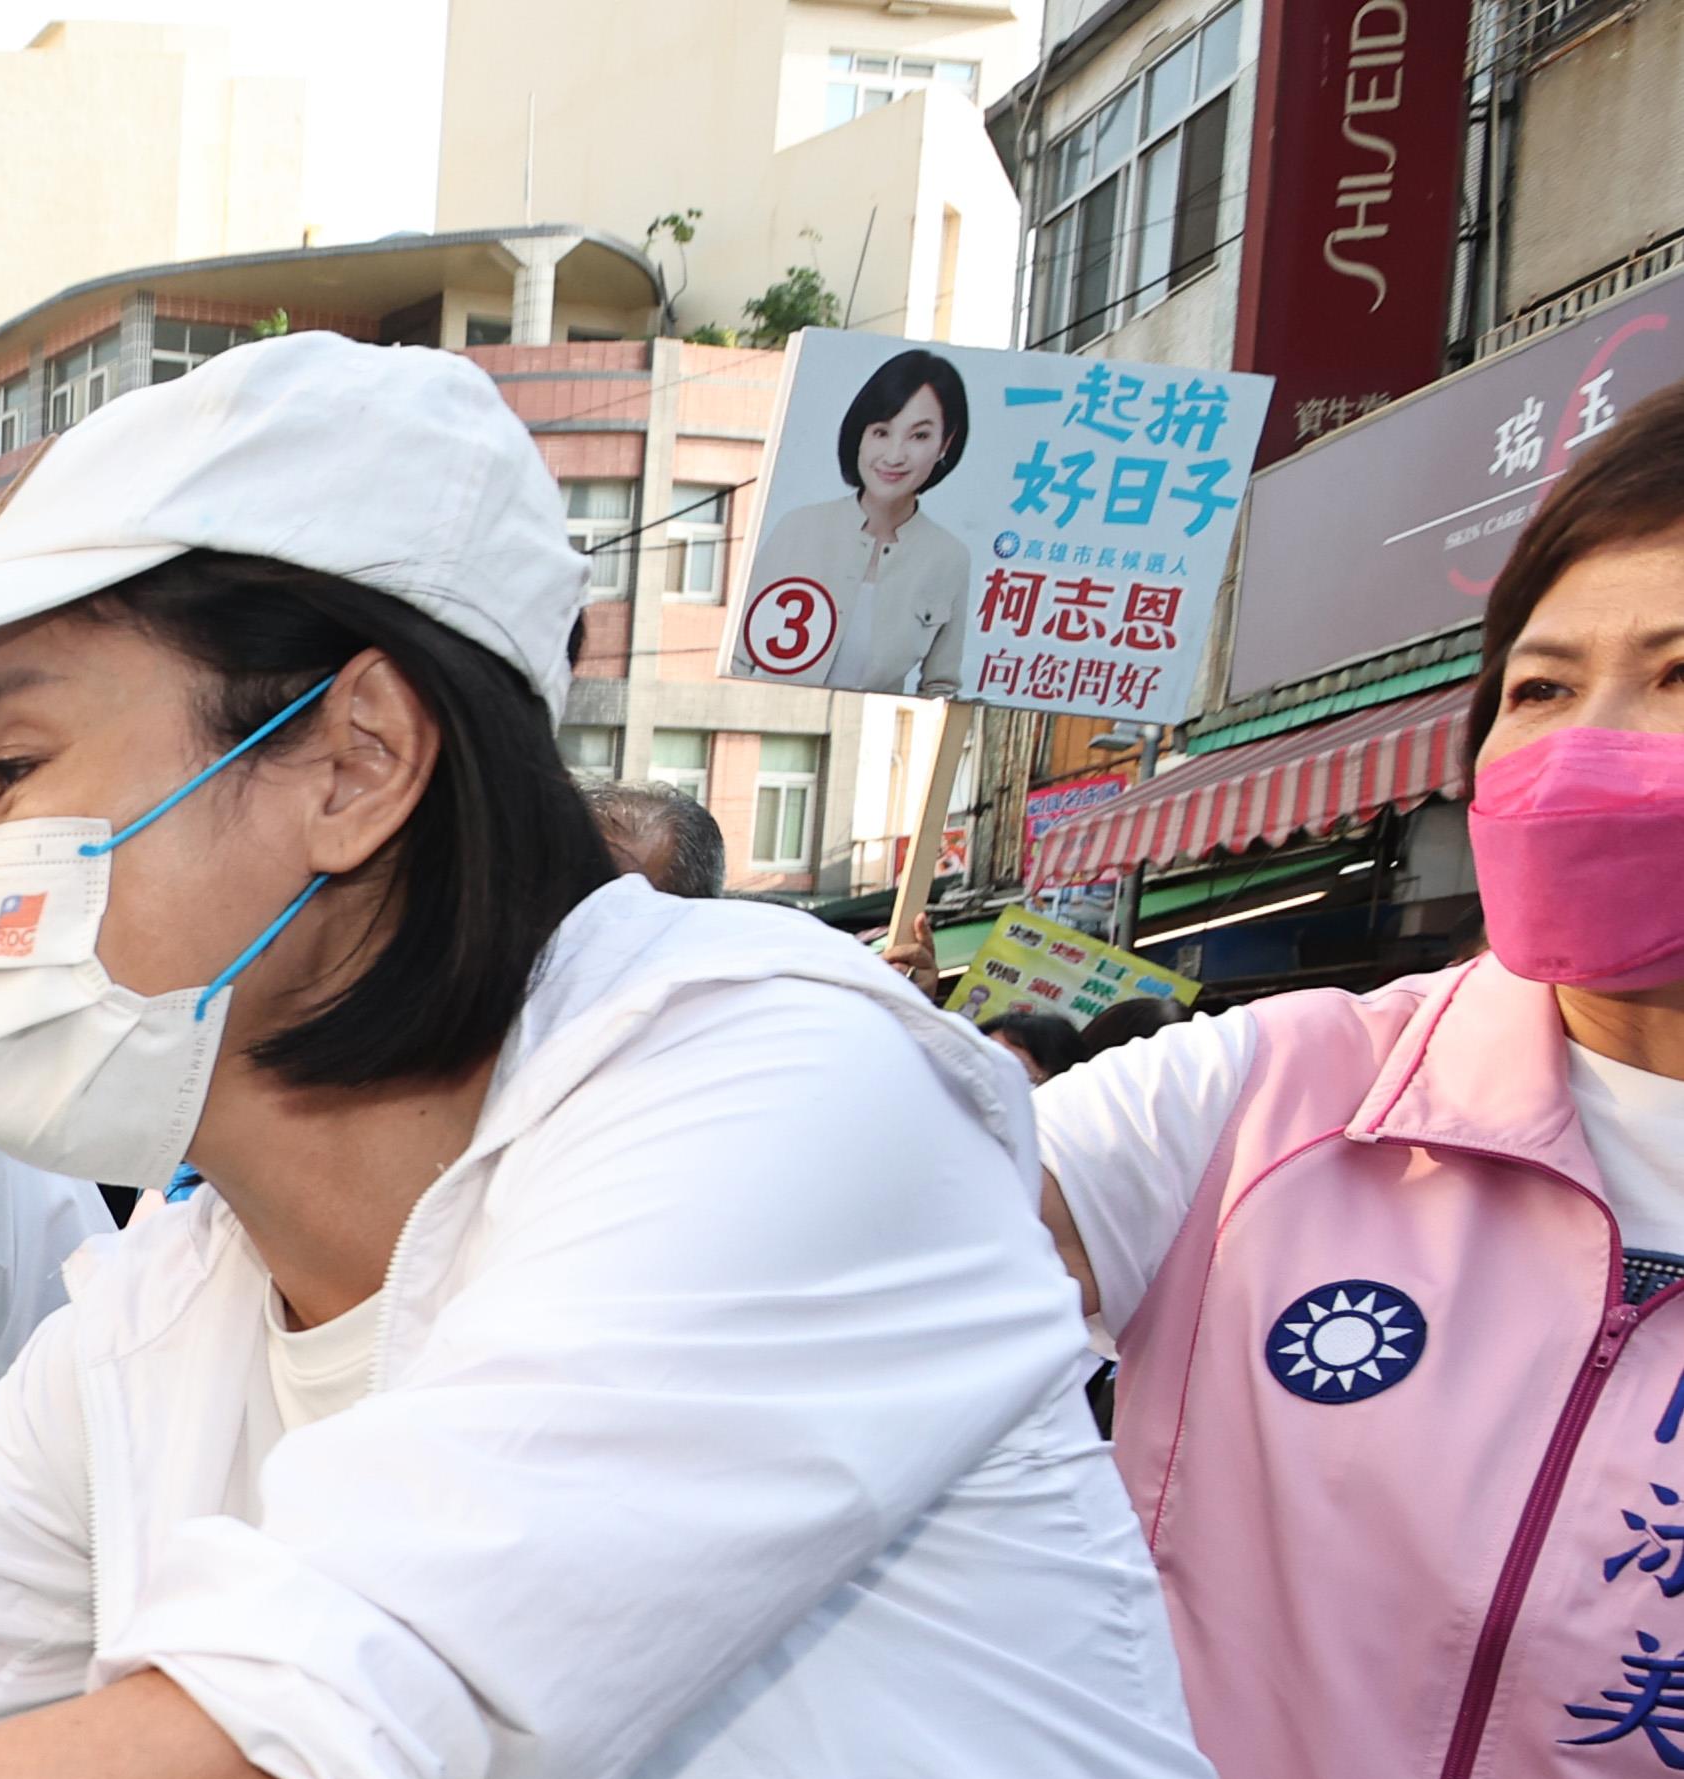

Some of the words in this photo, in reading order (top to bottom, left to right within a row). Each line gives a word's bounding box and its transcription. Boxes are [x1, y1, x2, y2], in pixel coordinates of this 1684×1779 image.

[1010, 441, 1238, 538] 好日子
[1483, 506, 1529, 538] CARE
[1023, 538, 1189, 577] 高雄市長候選人
[766, 589, 815, 660] 3
[976, 567, 1184, 652] 柯志恩
[977, 648, 1163, 711] 向您問好
[179, 1036, 208, 1094] Taiwan
